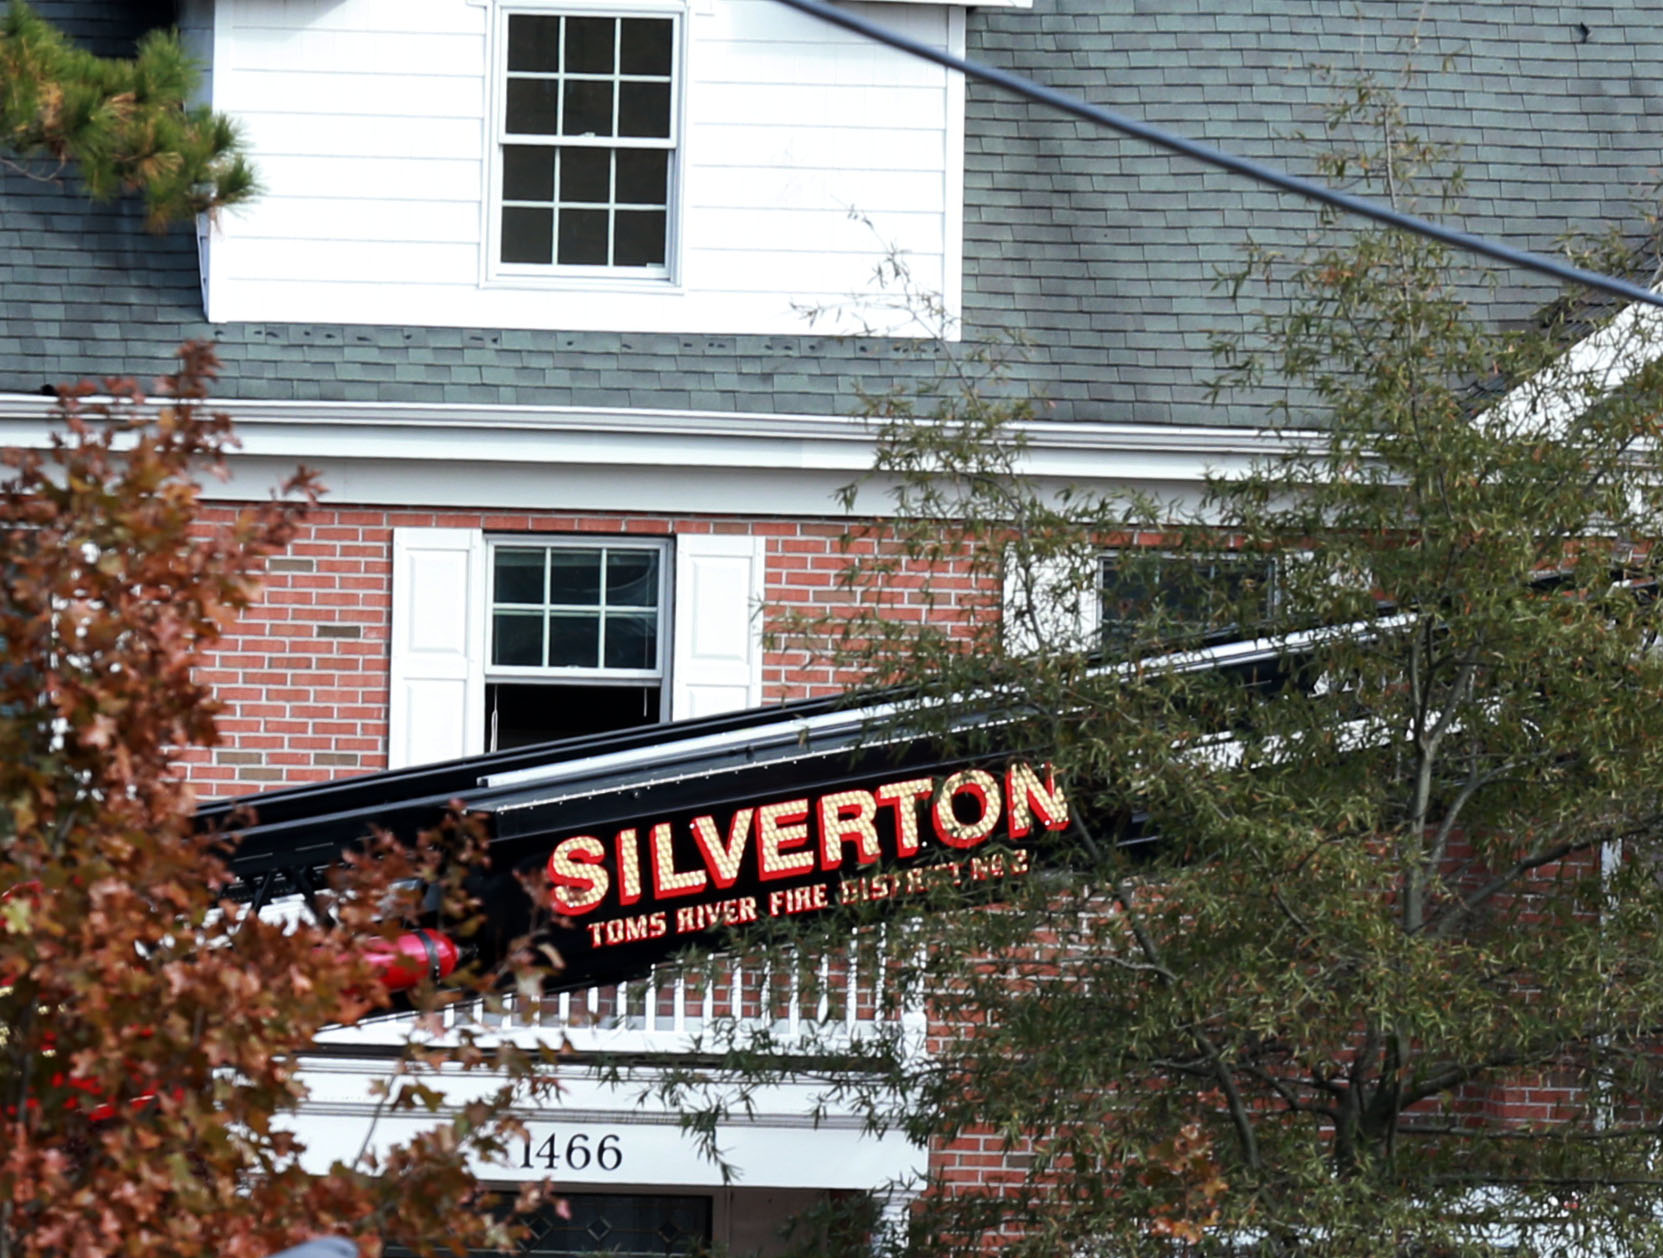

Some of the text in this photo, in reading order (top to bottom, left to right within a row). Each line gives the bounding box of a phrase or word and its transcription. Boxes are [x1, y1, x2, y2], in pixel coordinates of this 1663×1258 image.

[547, 761, 1070, 914] SILVERTON
[587, 911, 667, 948] TOMS
[675, 896, 757, 933] RIVER
[769, 883, 828, 916] FIRE
[841, 862, 963, 905] DISTRT
[520, 1132, 622, 1171] 1466
